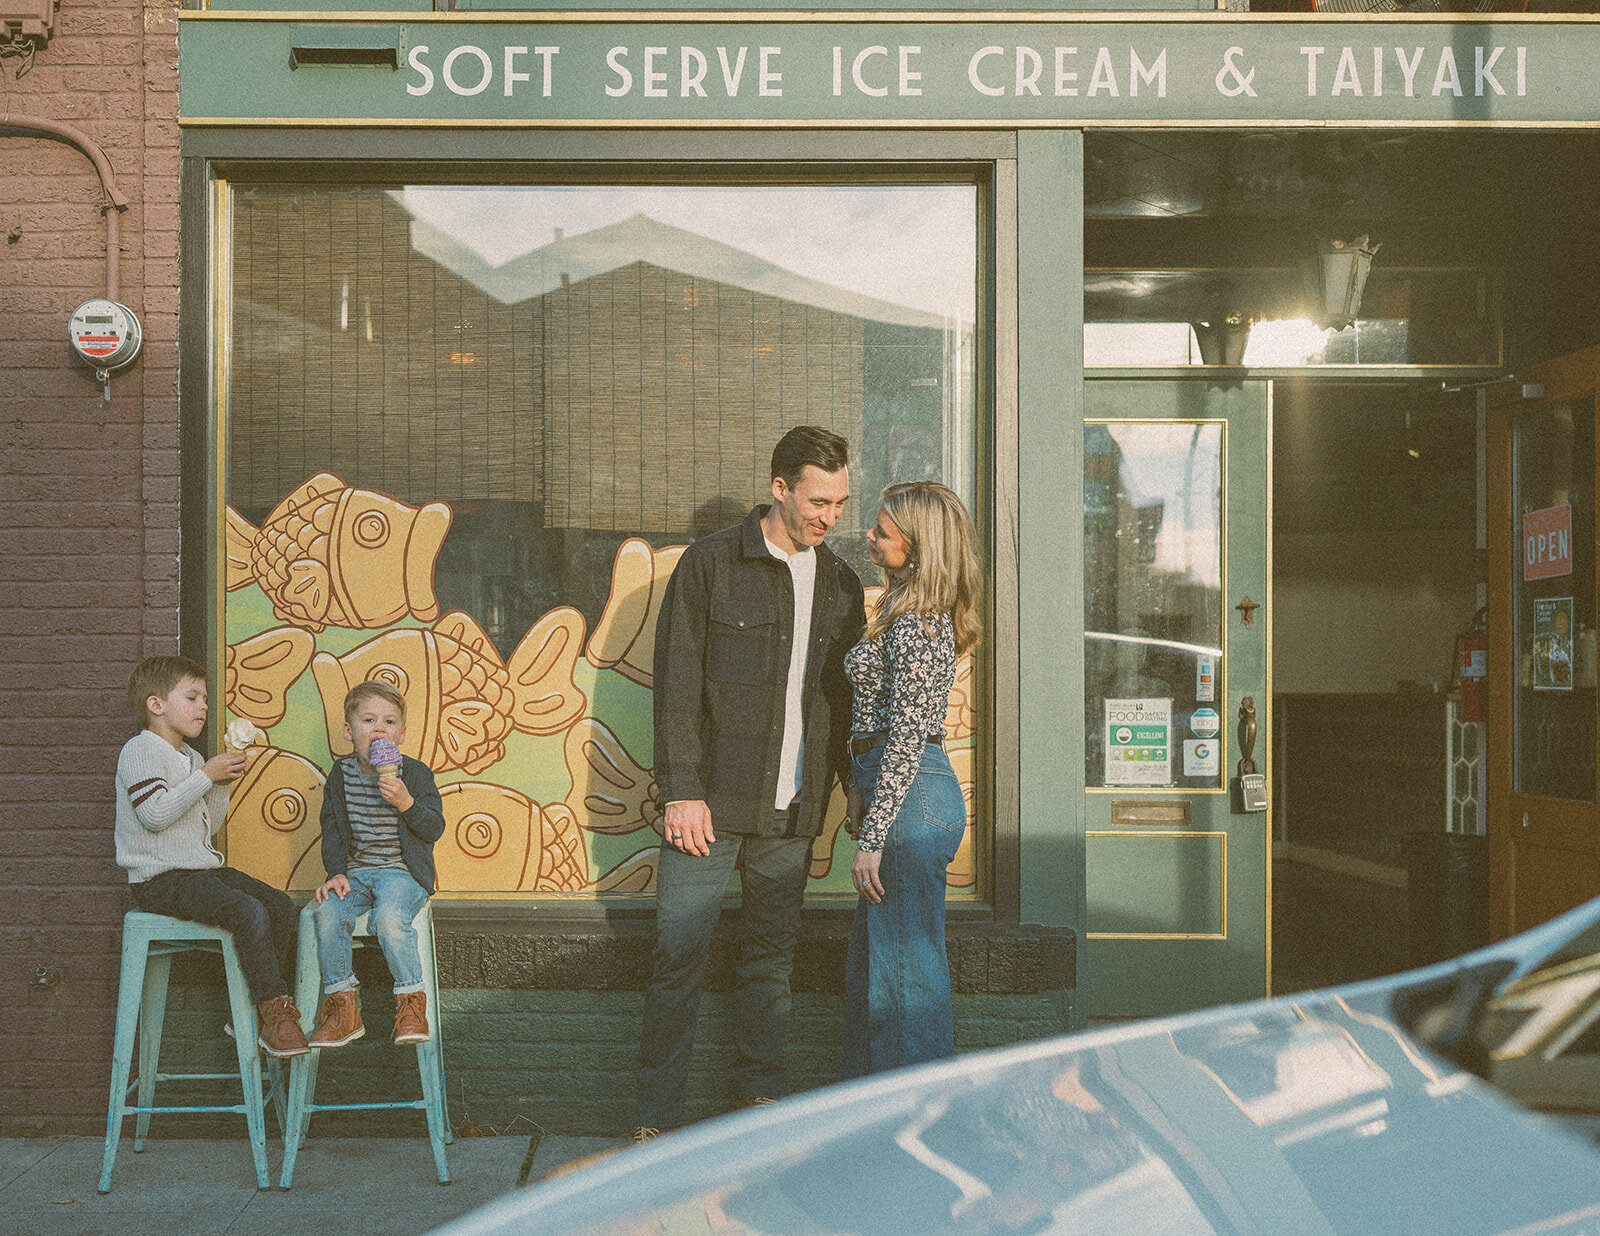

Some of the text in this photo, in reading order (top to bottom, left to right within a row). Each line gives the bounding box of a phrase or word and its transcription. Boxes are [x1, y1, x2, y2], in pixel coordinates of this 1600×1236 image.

[406, 45, 1527, 97] SOFT SERVE ICE CREAM & TAIYAKI
[1527, 529, 1568, 565] OPEN
[1109, 711, 1144, 721] FOOD
[1136, 731, 1165, 740] EXCELLENT
